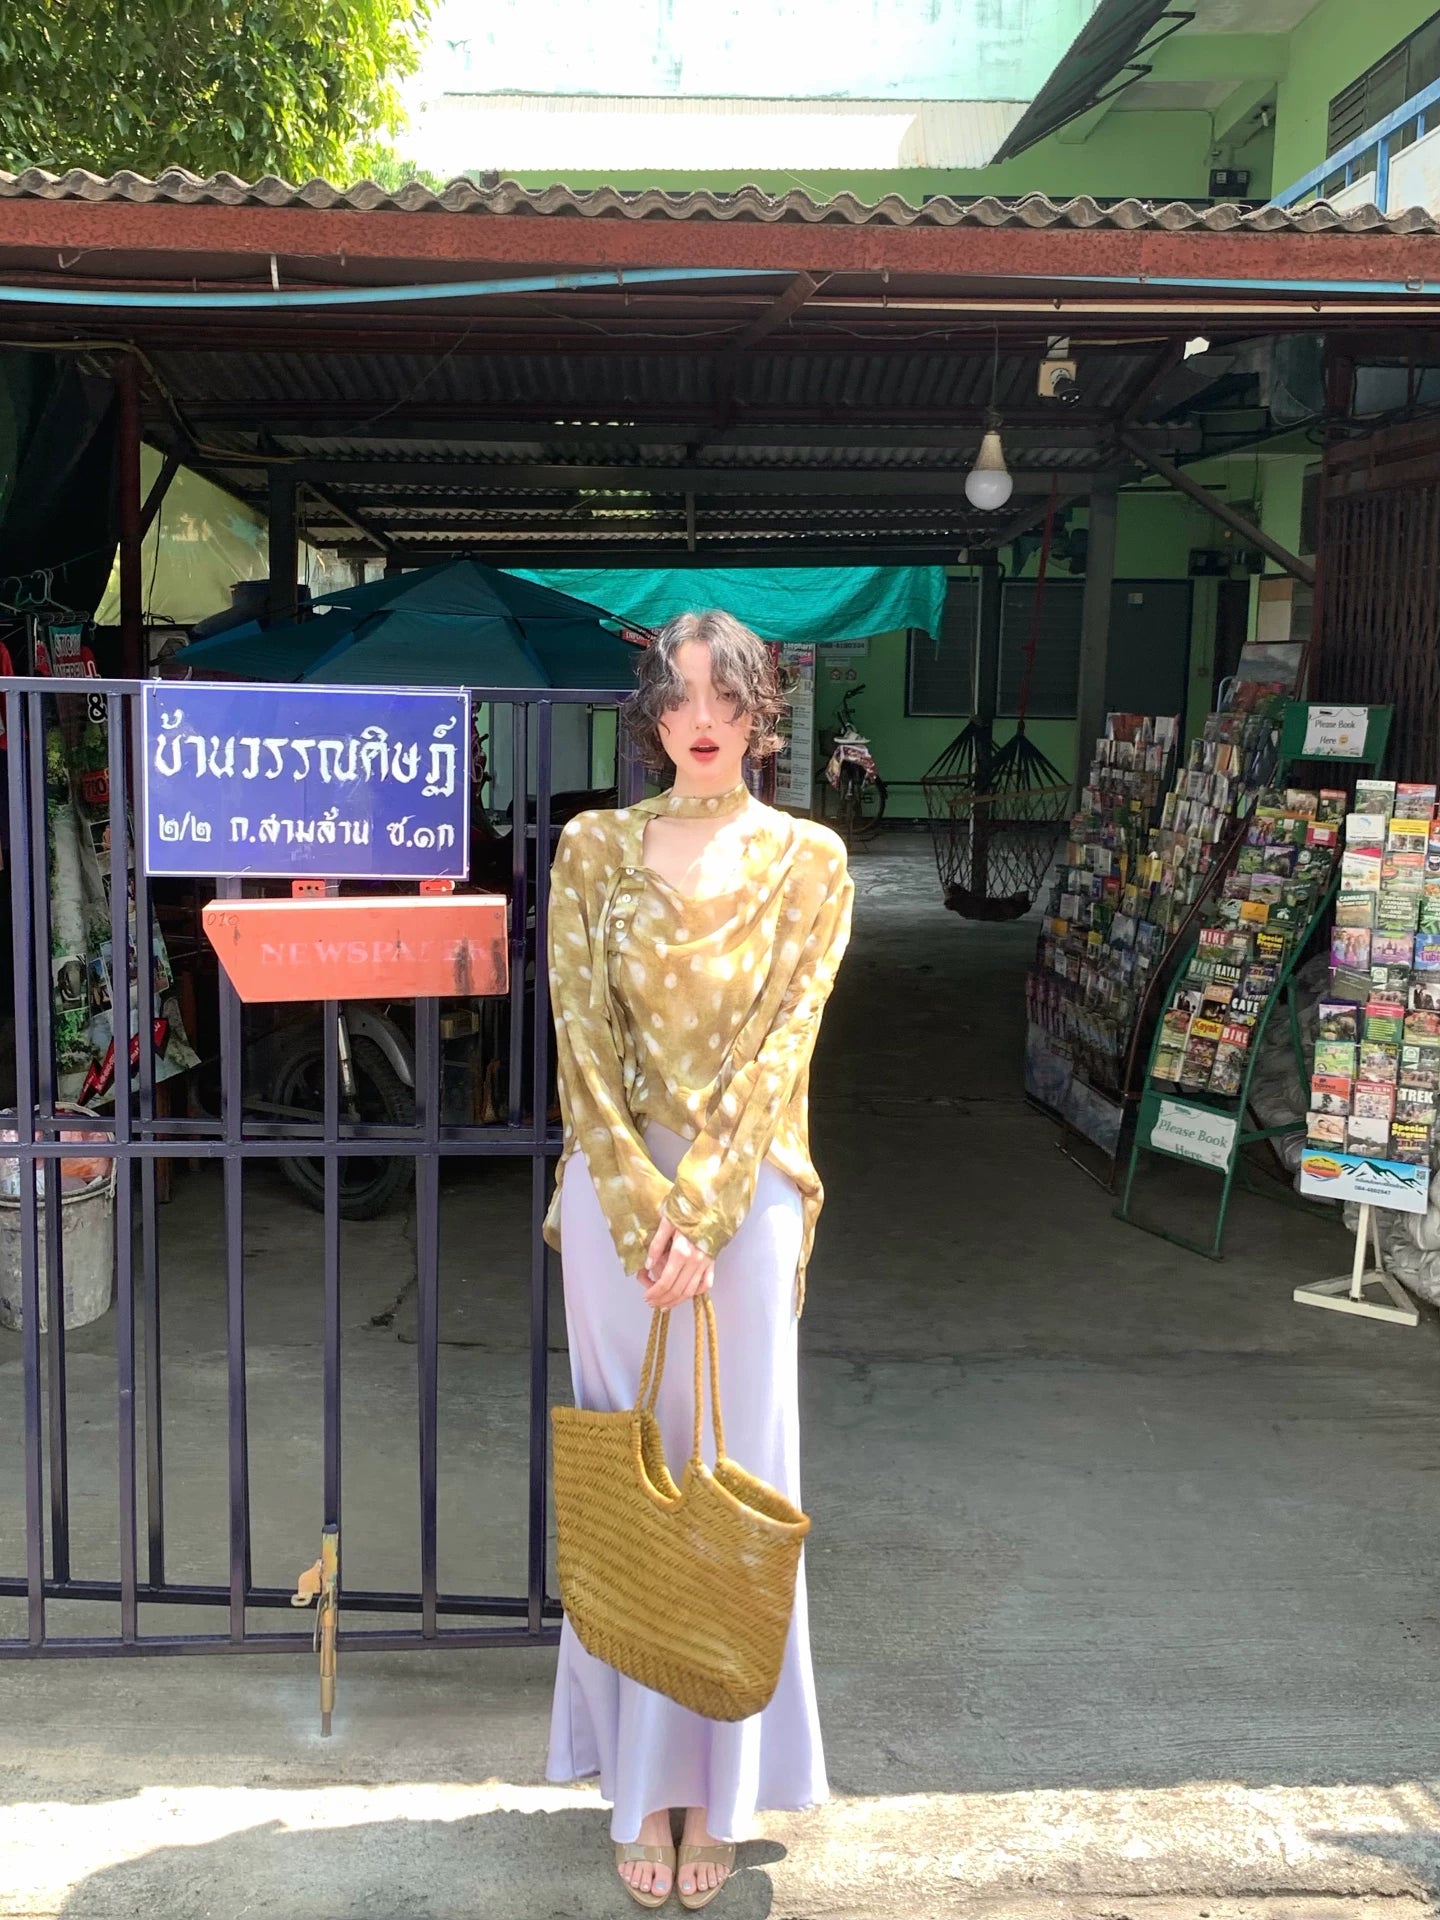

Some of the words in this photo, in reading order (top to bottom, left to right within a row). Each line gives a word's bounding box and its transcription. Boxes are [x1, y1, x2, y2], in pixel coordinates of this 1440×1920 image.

[1314, 720, 1336, 729] Please
[1338, 720, 1355, 728] Book
[1320, 736, 1336, 744] Here
[1199, 930, 1225, 945] HIKE
[1215, 963, 1241, 979] KAYAK
[1231, 997, 1259, 1013] CAVE
[1222, 1027, 1249, 1044] BIKE
[1399, 1088, 1434, 1104] TREK
[1159, 1120, 1195, 1138] Please
[1197, 1130, 1229, 1148] Book
[1391, 1122, 1428, 1133] Special
[1391, 1130, 1427, 1139] Program
[1175, 1144, 1202, 1160] Here
